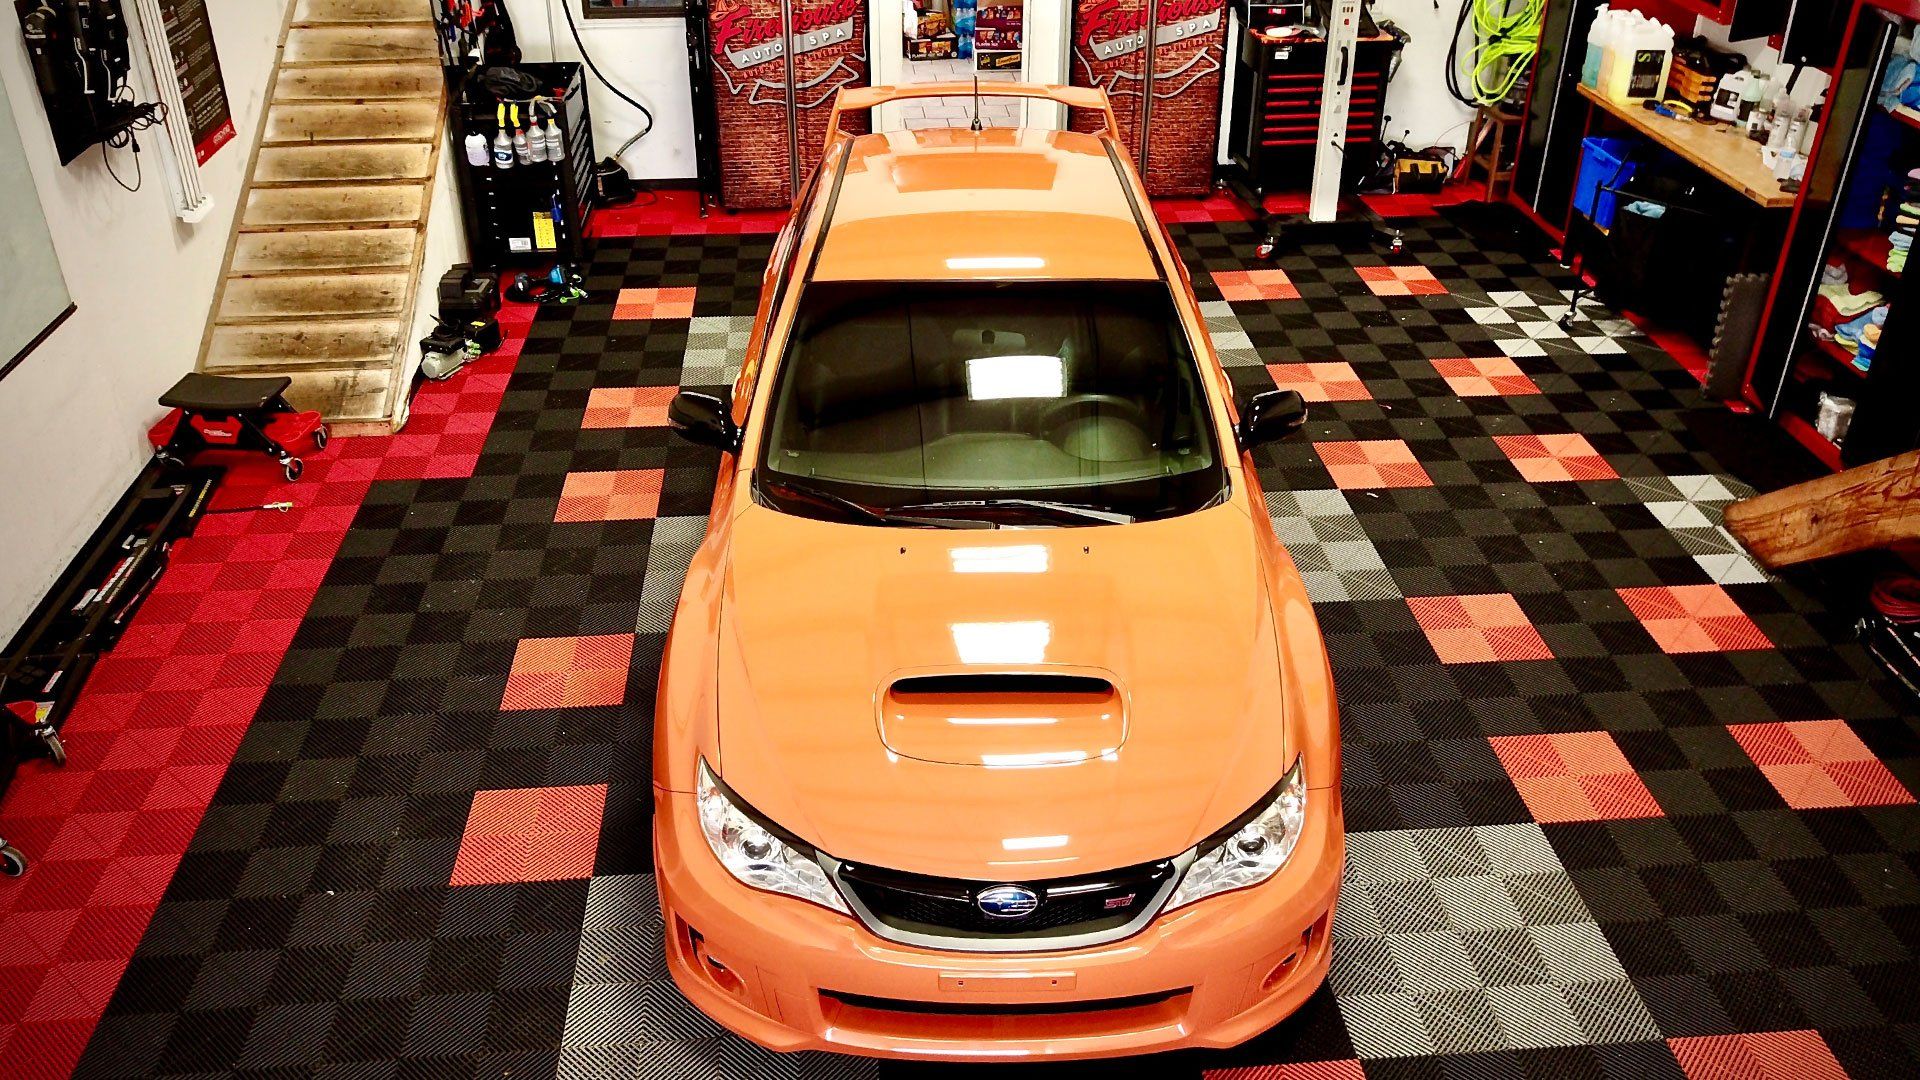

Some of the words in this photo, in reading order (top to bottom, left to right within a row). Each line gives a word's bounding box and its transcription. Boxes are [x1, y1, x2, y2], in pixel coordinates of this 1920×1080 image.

[742, 43, 783, 64] AUTO
[809, 28, 845, 45] SPA
[1104, 35, 1144, 55] AUTO
[1176, 21, 1212, 36] SPA
